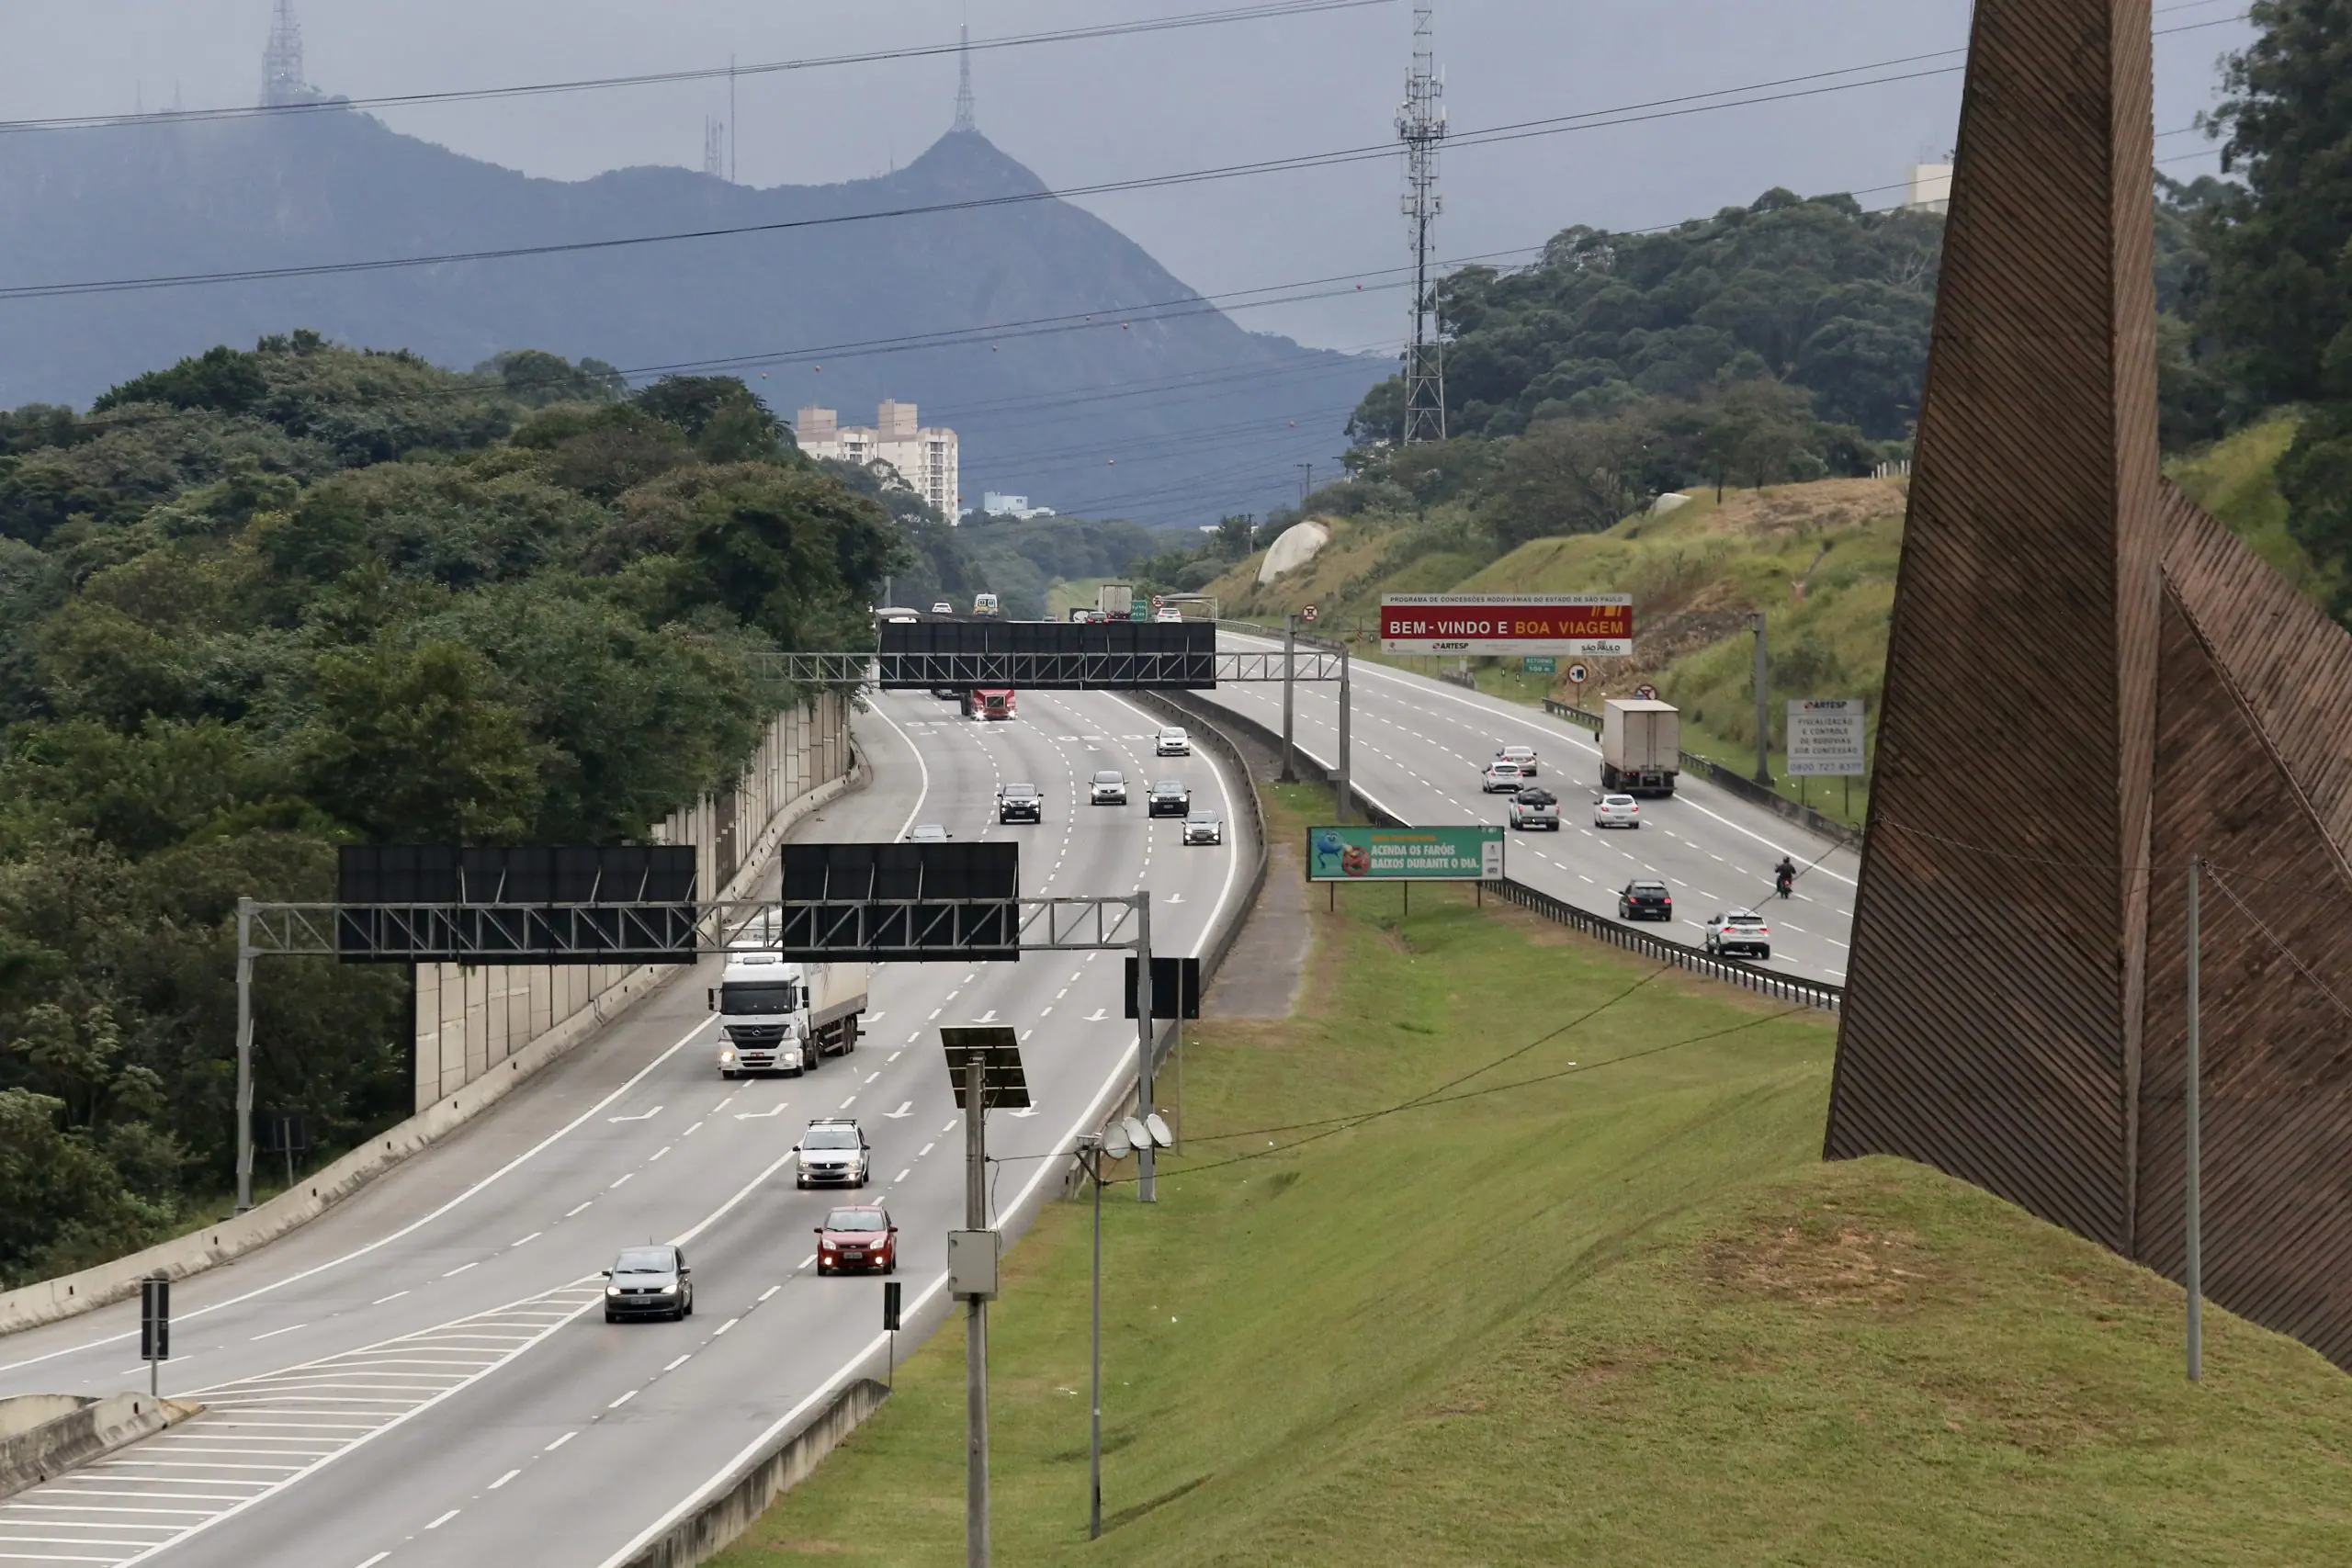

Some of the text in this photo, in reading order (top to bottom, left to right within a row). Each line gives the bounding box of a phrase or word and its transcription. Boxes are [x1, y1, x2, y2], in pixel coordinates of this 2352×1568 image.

[1498, 621, 1508, 634] E
[1515, 621, 1550, 634] BOA
[1558, 621, 1623, 634] VIAGEM
[1815, 701, 1847, 709] ARTESP
[1371, 842, 1455, 855] ACENDA OS FARÓIS
[1371, 858, 1404, 868] BAIXOS
[1407, 858, 1449, 868] DURANTE
[1451, 858, 1459, 868] O
[1461, 858, 1480, 868] DIA.
